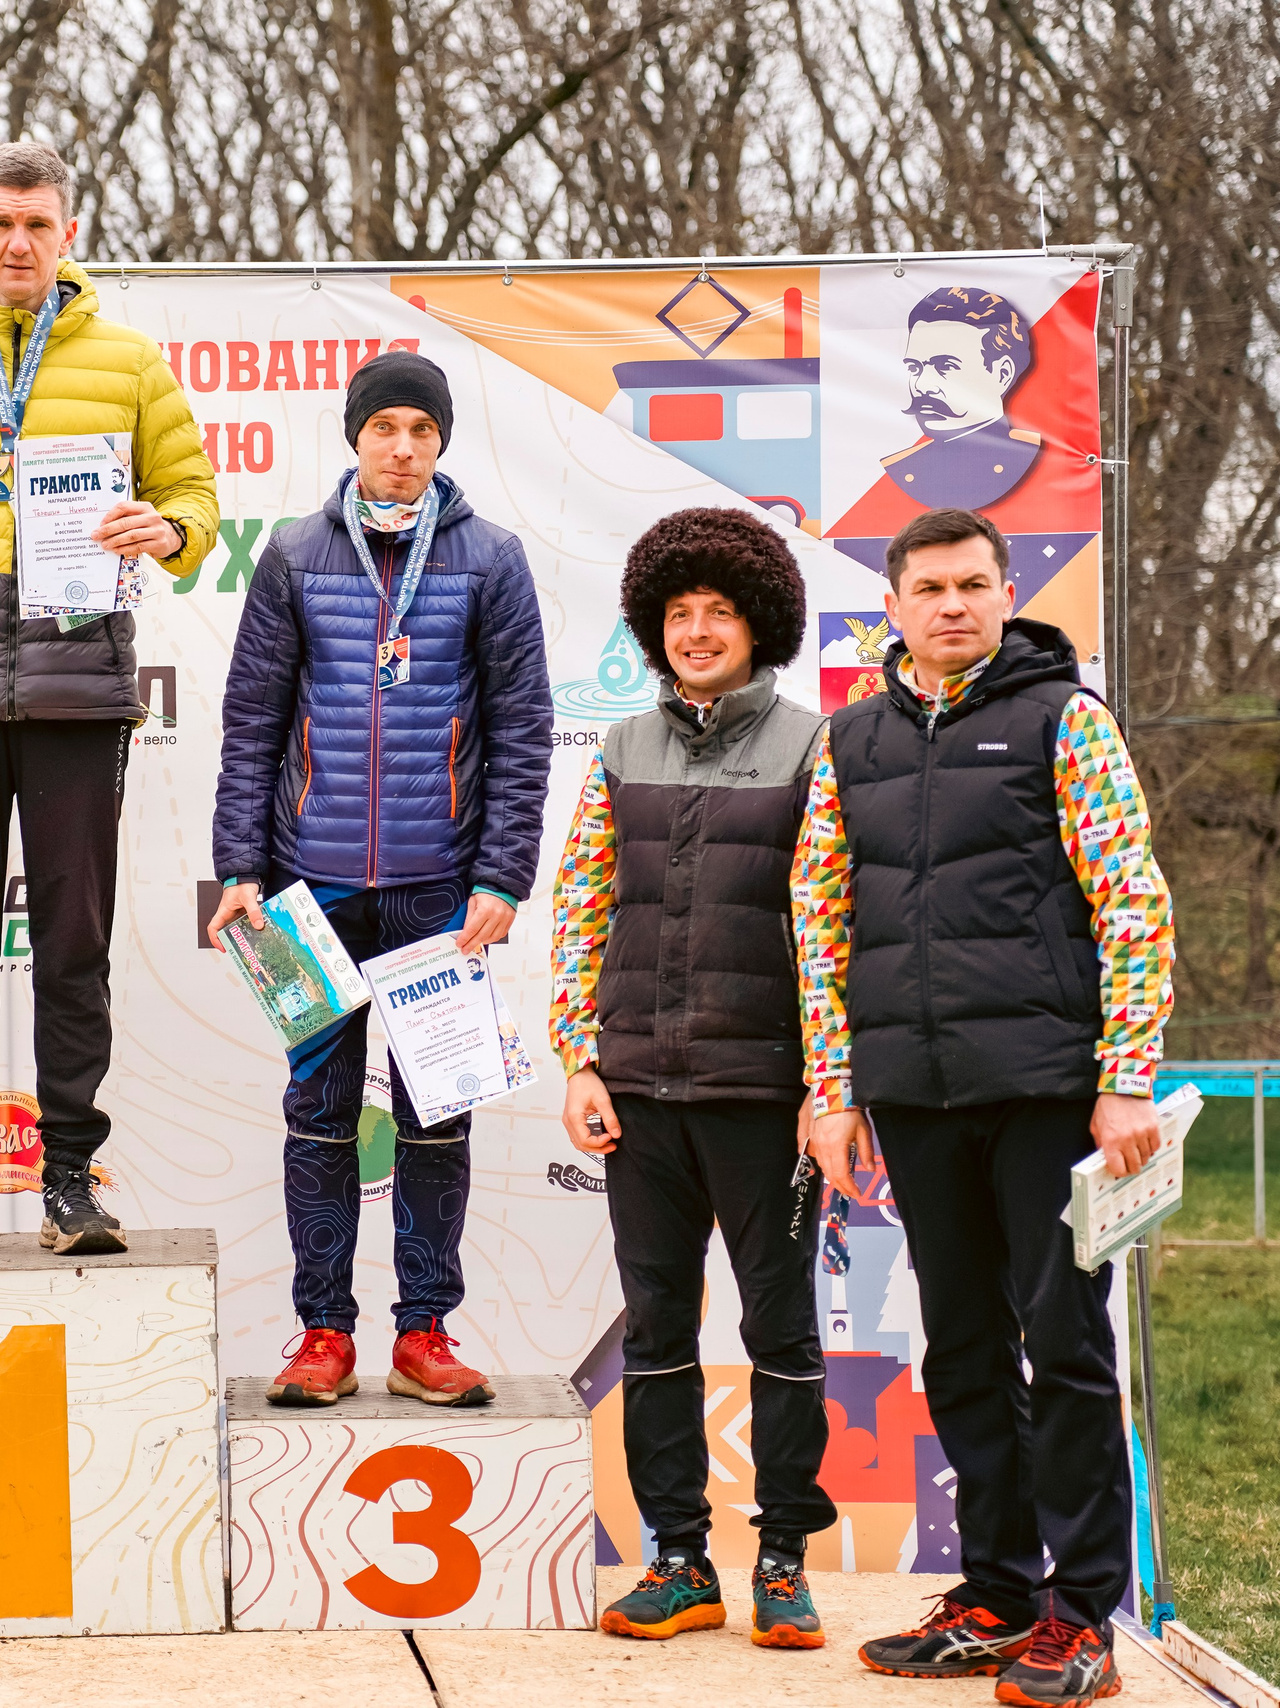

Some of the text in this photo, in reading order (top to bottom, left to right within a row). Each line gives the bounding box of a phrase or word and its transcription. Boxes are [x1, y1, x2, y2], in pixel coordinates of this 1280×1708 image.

[16, 352, 31, 392] ВОЕННОГО
[28, 310, 48, 352] ТОПОГРАФА
[27, 339, 46, 381] ПАСТУХОВА
[46, 457, 76, 465] ТОПОГРАФА
[77, 454, 107, 462] ПАСТУХОВА
[30, 472, 101, 496] ГРАМОТА
[47, 496, 86, 504] НАГРАЖДАЕТСЯ
[35, 538, 65, 546] СПОРТИВНОГО
[417, 527, 434, 569] ПАСТУХОВА
[68, 551, 105, 559] КРОСС-КЛАССИКА
[396, 499, 432, 611] ПАМЯТИ ВОЕННОГО ТОПОГРАФА
[381, 646, 389, 660] 3
[144, 735, 177, 745] вело
[551, 731, 598, 746] евая
[228, 924, 264, 975] ПЯТИГОРСК
[292, 914, 310, 941] ПОЛЕЗНЫЕ
[308, 940, 326, 967] СЛАДОСТИ
[323, 964, 338, 986] КУРОРТА
[428, 948, 459, 965] ПАСТУХОВА
[232, 954, 244, 970] ОСНОВЕ
[241, 968, 262, 1001] МИНЕРАЛЬНЫХ
[265, 1008, 279, 1030] КАВКАЗА
[387, 968, 462, 1009] ГРАМОТА
[413, 997, 451, 1014] НАГРАЖДАЕТСЯ
[441, 1019, 457, 1028] МЕСТО
[413, 1026, 480, 1056] СПОРТИВНОГО ОРИЕНТИРОВАНИЯ
[433, 1027, 457, 1040] ФЕСТИВАЛЕ
[415, 1050, 440, 1063] ВОЗРАСТНАЯ
[449, 1041, 485, 1058] КРОСС-КЛАССИКА
[360, 1181, 393, 1198] ашук
[343, 1444, 482, 1619] 3
